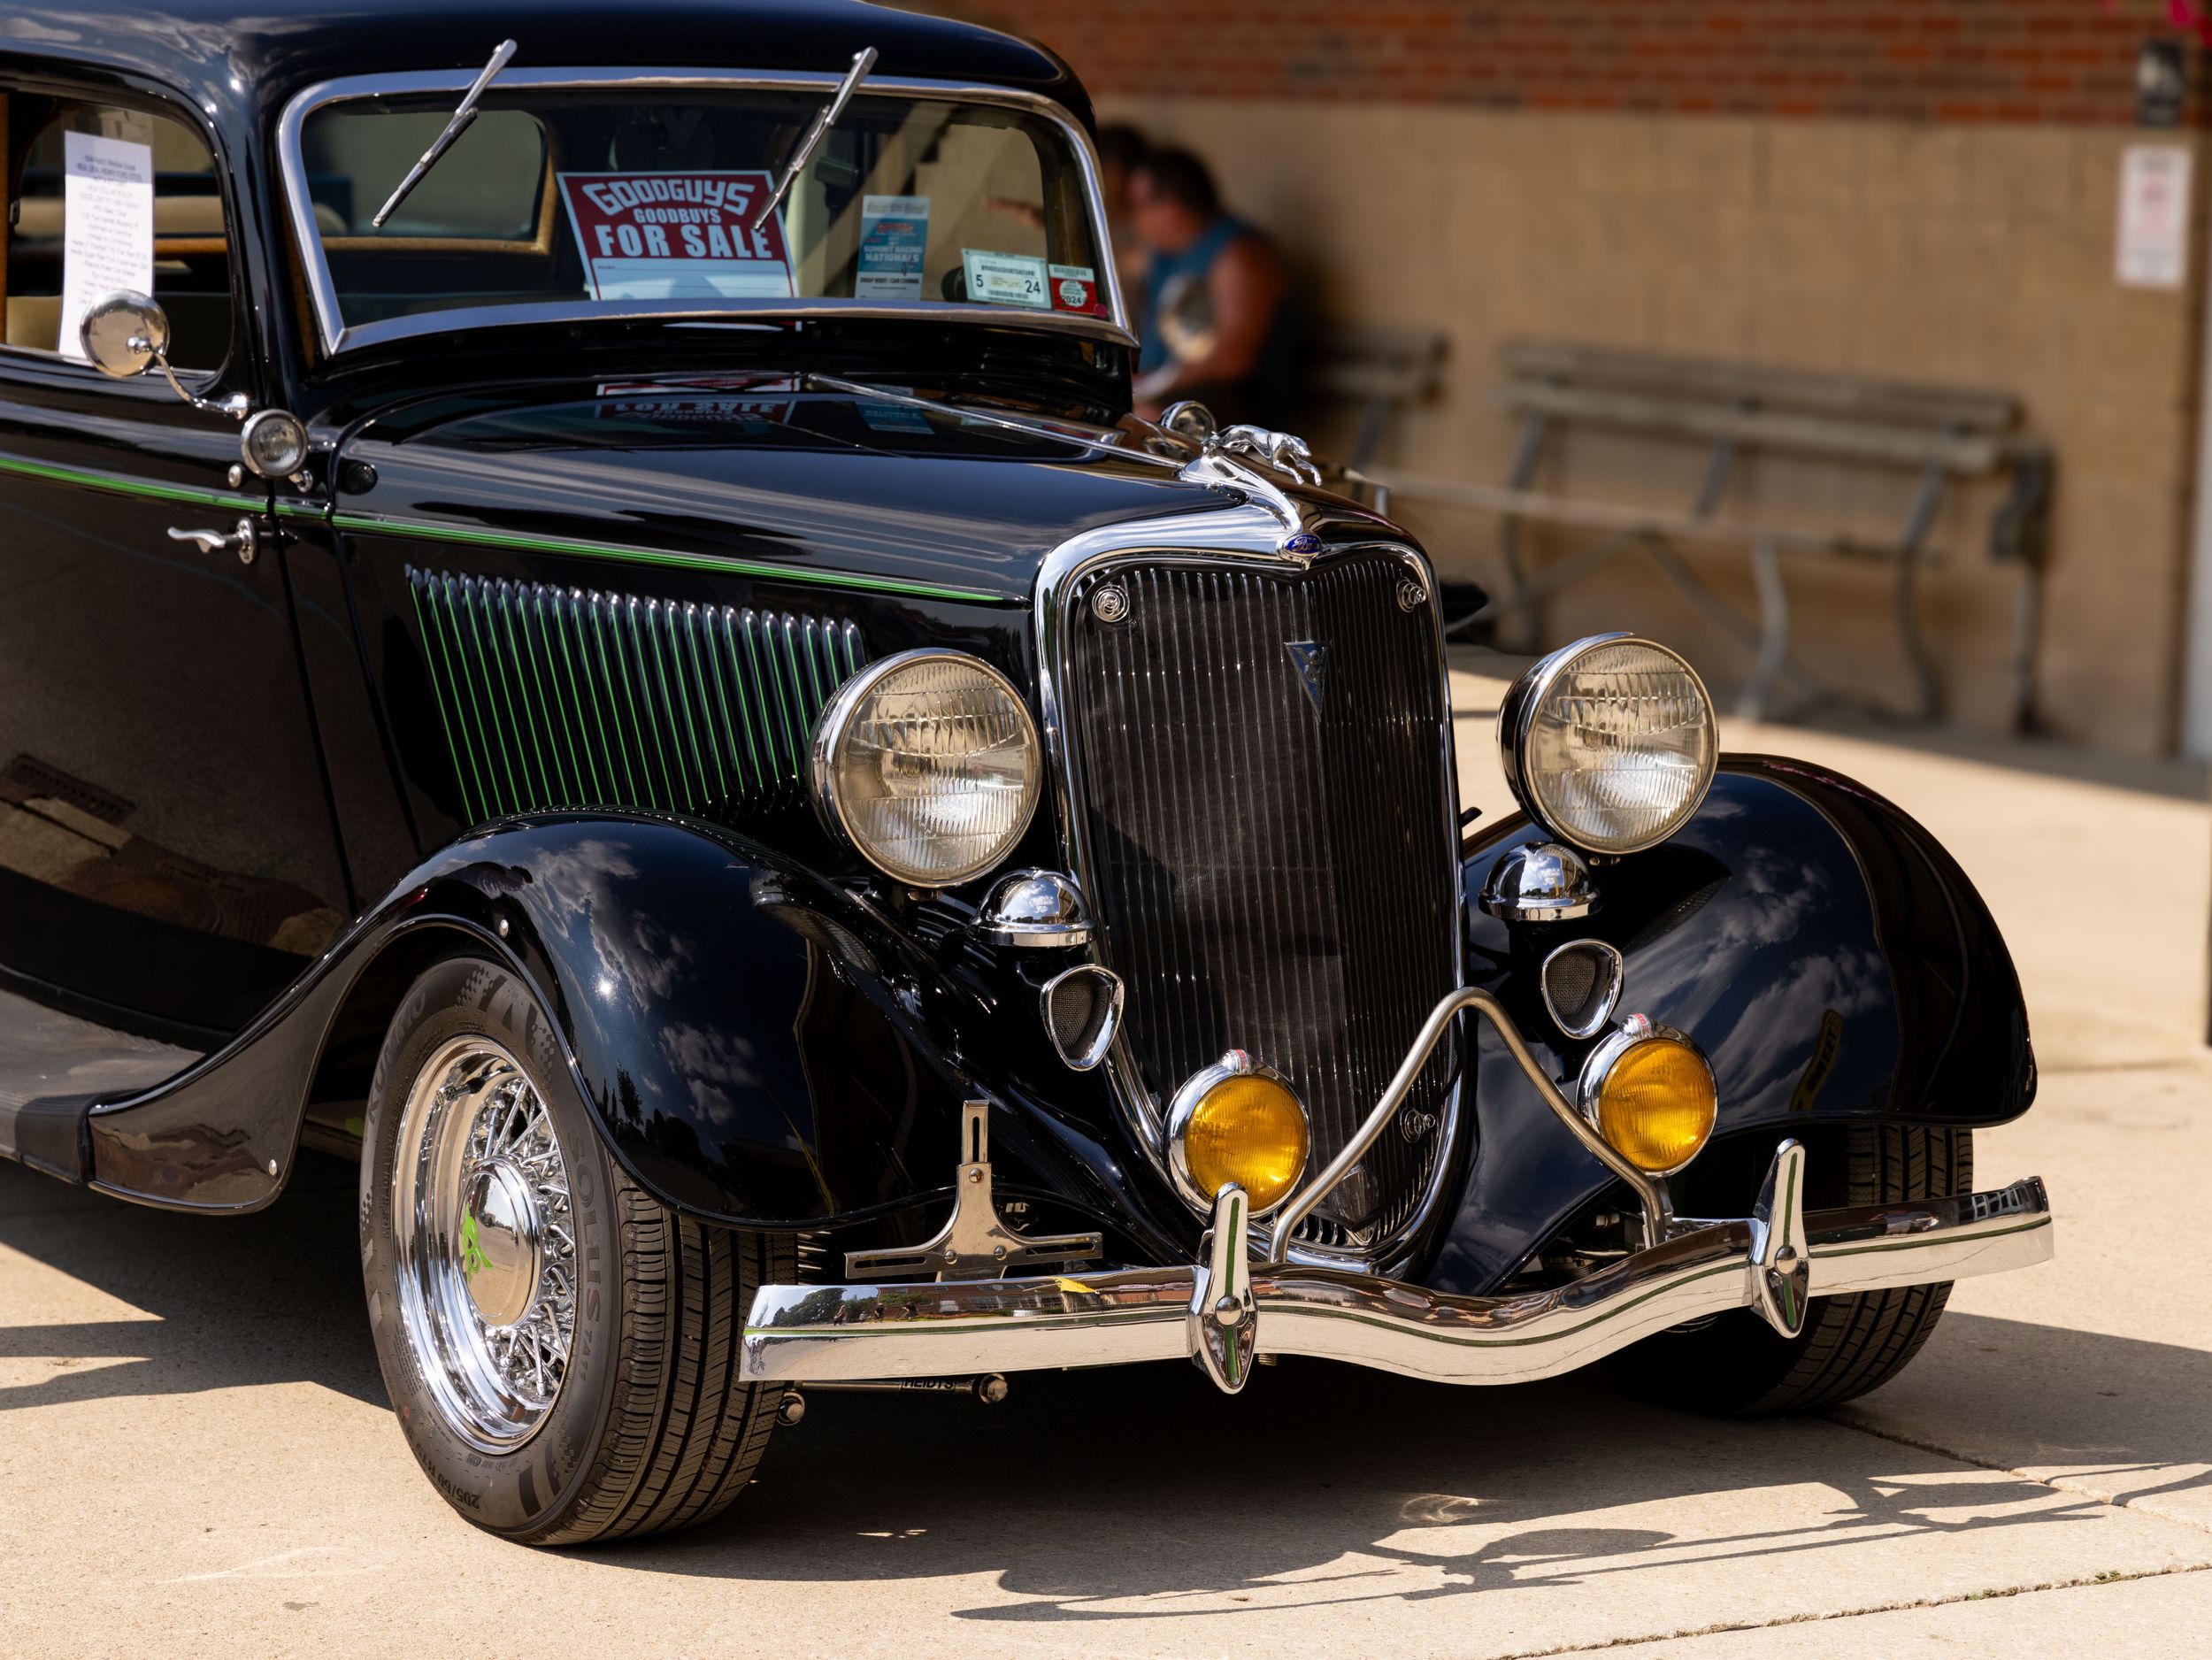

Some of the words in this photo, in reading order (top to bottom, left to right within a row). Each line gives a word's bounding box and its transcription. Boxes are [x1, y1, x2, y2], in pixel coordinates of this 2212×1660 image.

[582, 179, 755, 216] GOODGUYS
[634, 208, 721, 223] GOODBUYS
[595, 225, 670, 257] FOR
[680, 225, 773, 257] SALE
[976, 274, 984, 288] 5
[1025, 280, 1041, 294] 24
[569, 1132, 601, 1323] SOLUS
[438, 1472, 480, 1510] 205/60
